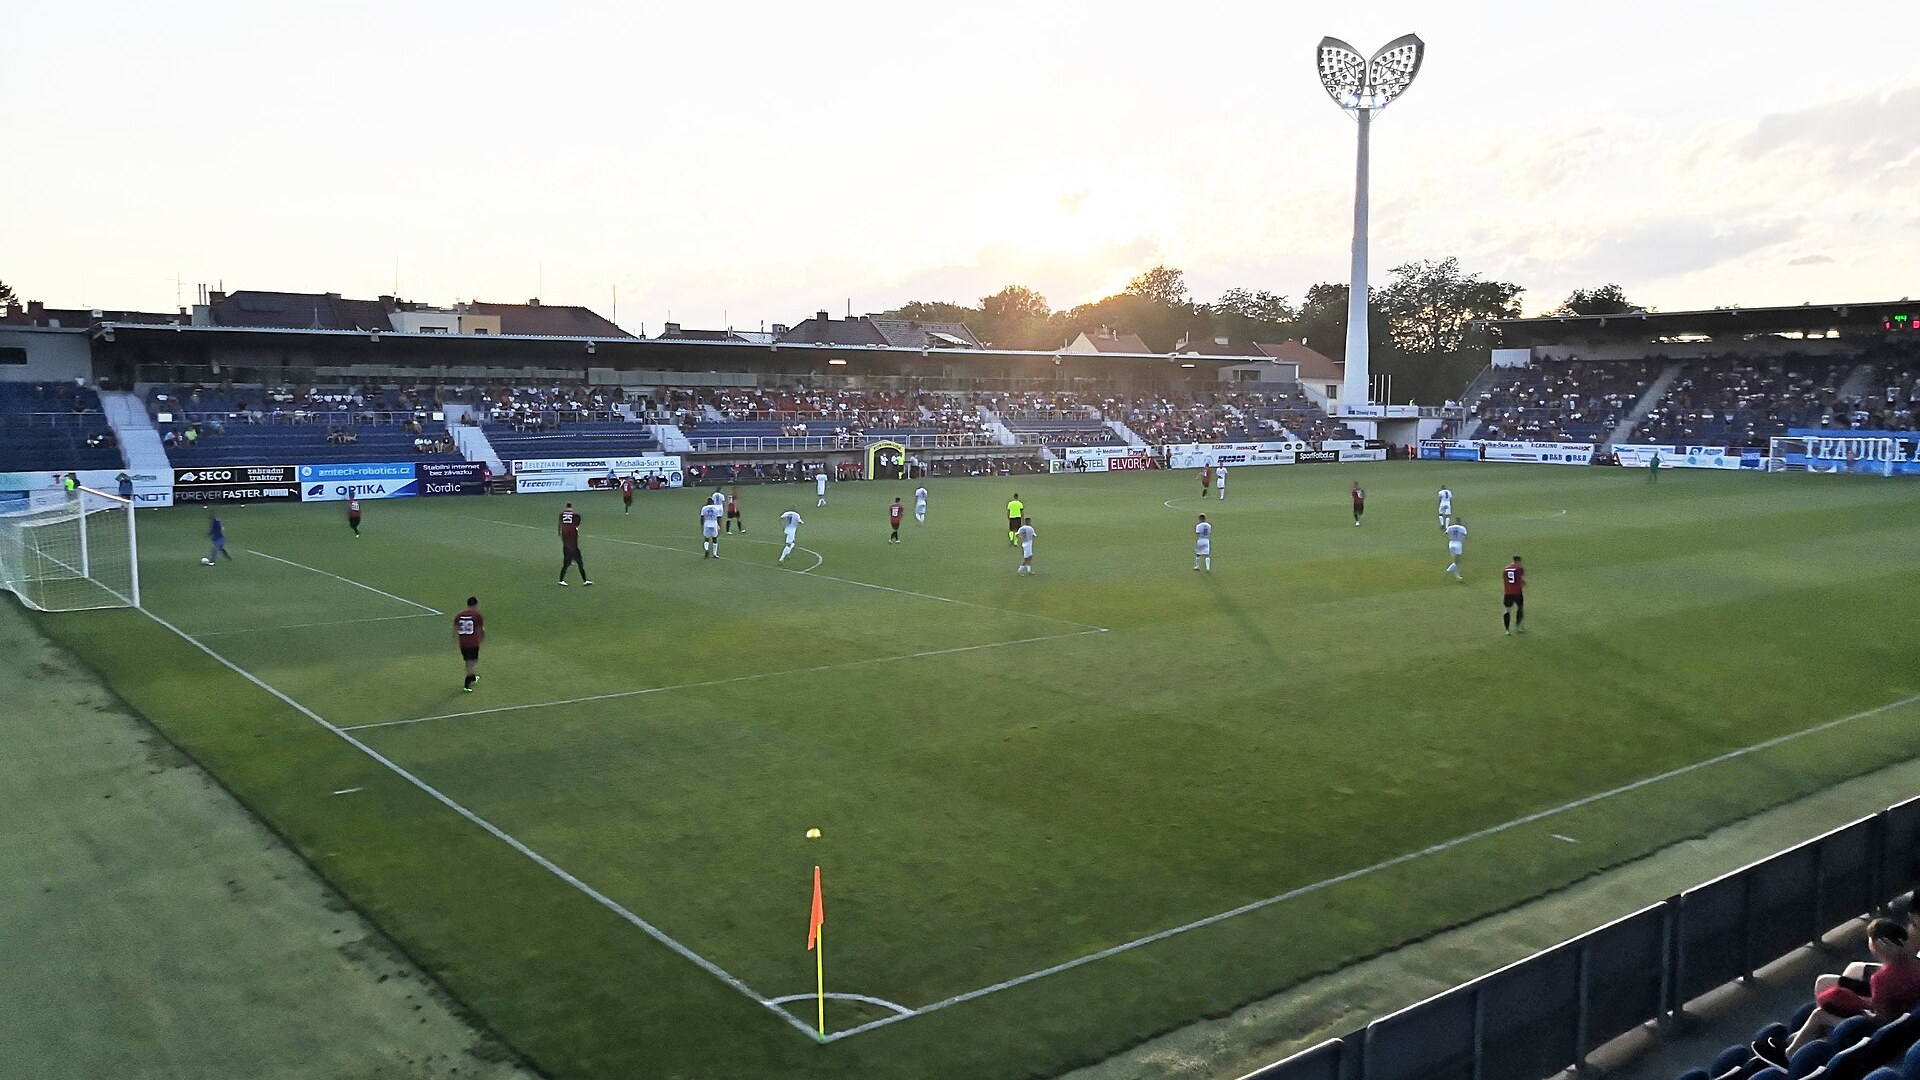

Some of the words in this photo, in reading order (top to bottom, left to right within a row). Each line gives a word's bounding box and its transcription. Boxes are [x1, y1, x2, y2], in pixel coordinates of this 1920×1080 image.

[198, 471, 232, 481] SECO
[318, 467, 411, 477] amtech-robotics.cz
[249, 474, 284, 482] traktory
[335, 484, 386, 496] OPTIKA
[425, 482, 461, 493] Nordic
[175, 490, 221, 500] FOREVER
[1507, 571, 1515, 584] 9
